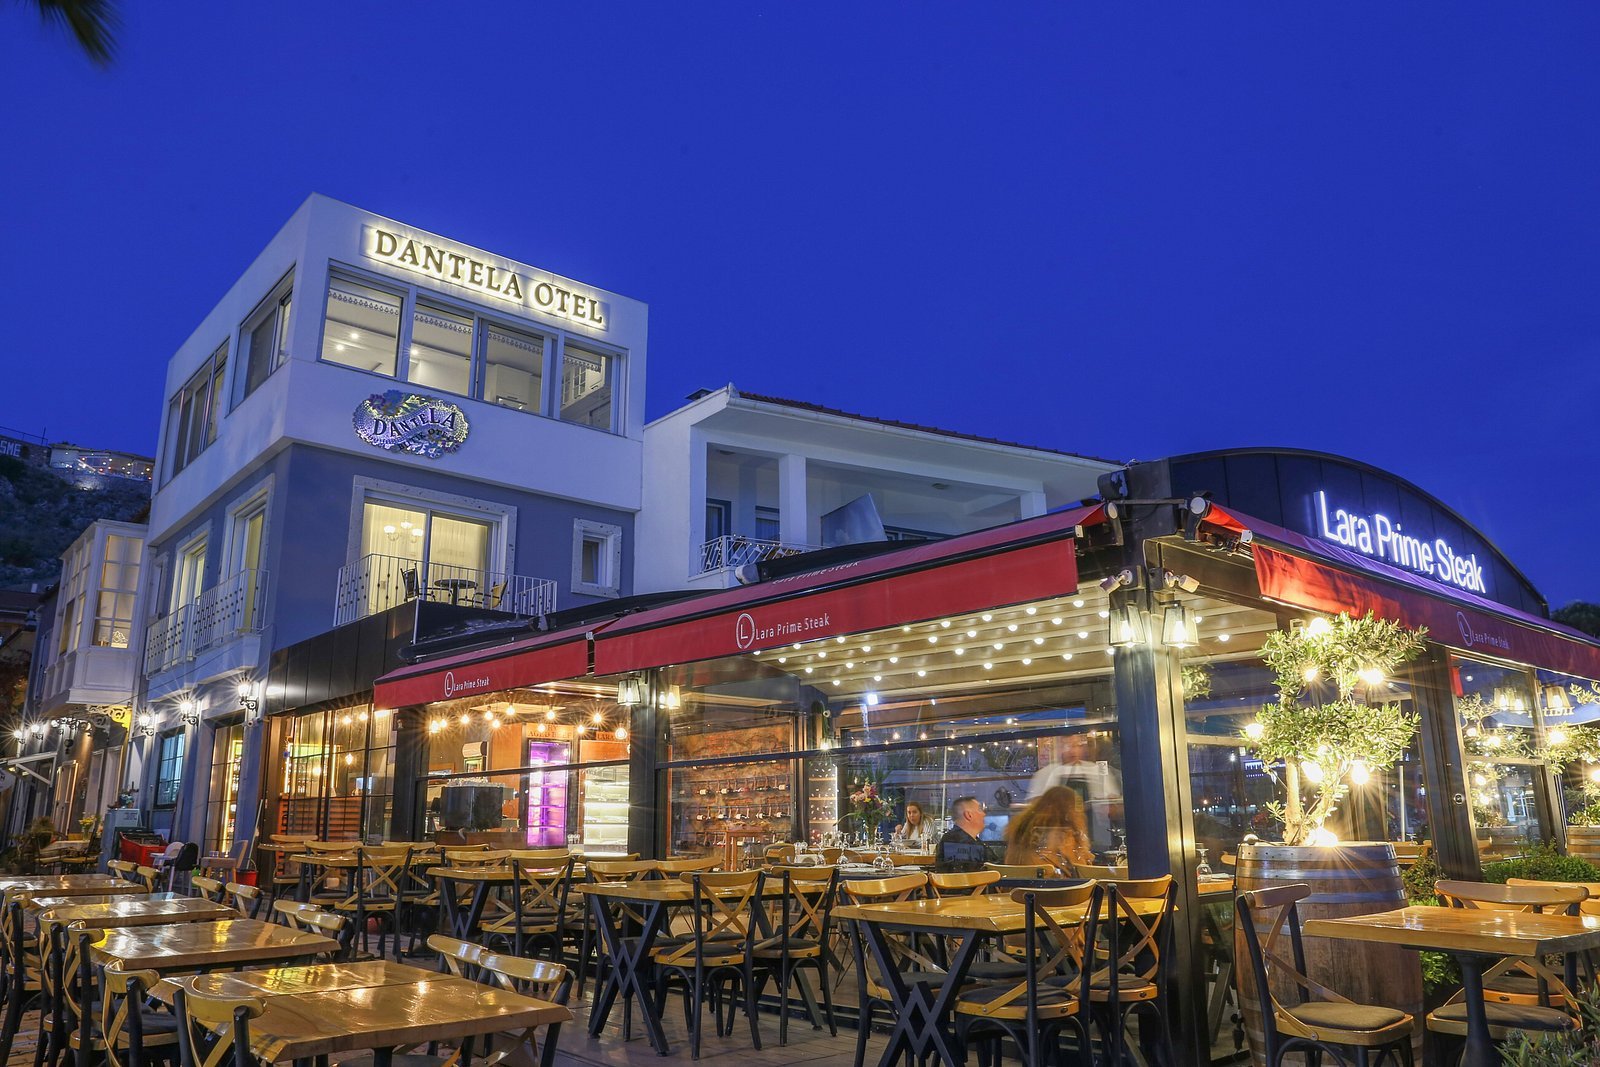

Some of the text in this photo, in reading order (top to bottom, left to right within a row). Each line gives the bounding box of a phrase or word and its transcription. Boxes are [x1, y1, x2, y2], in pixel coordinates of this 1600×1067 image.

[375, 229, 602, 324] DANTELA OTEL
[373, 407, 456, 437] DANTELA
[1316, 490, 1486, 593] Lara Prime Steak
[755, 612, 830, 640] Lara Prime Steak
[453, 676, 489, 691] Lara Prime Steak
